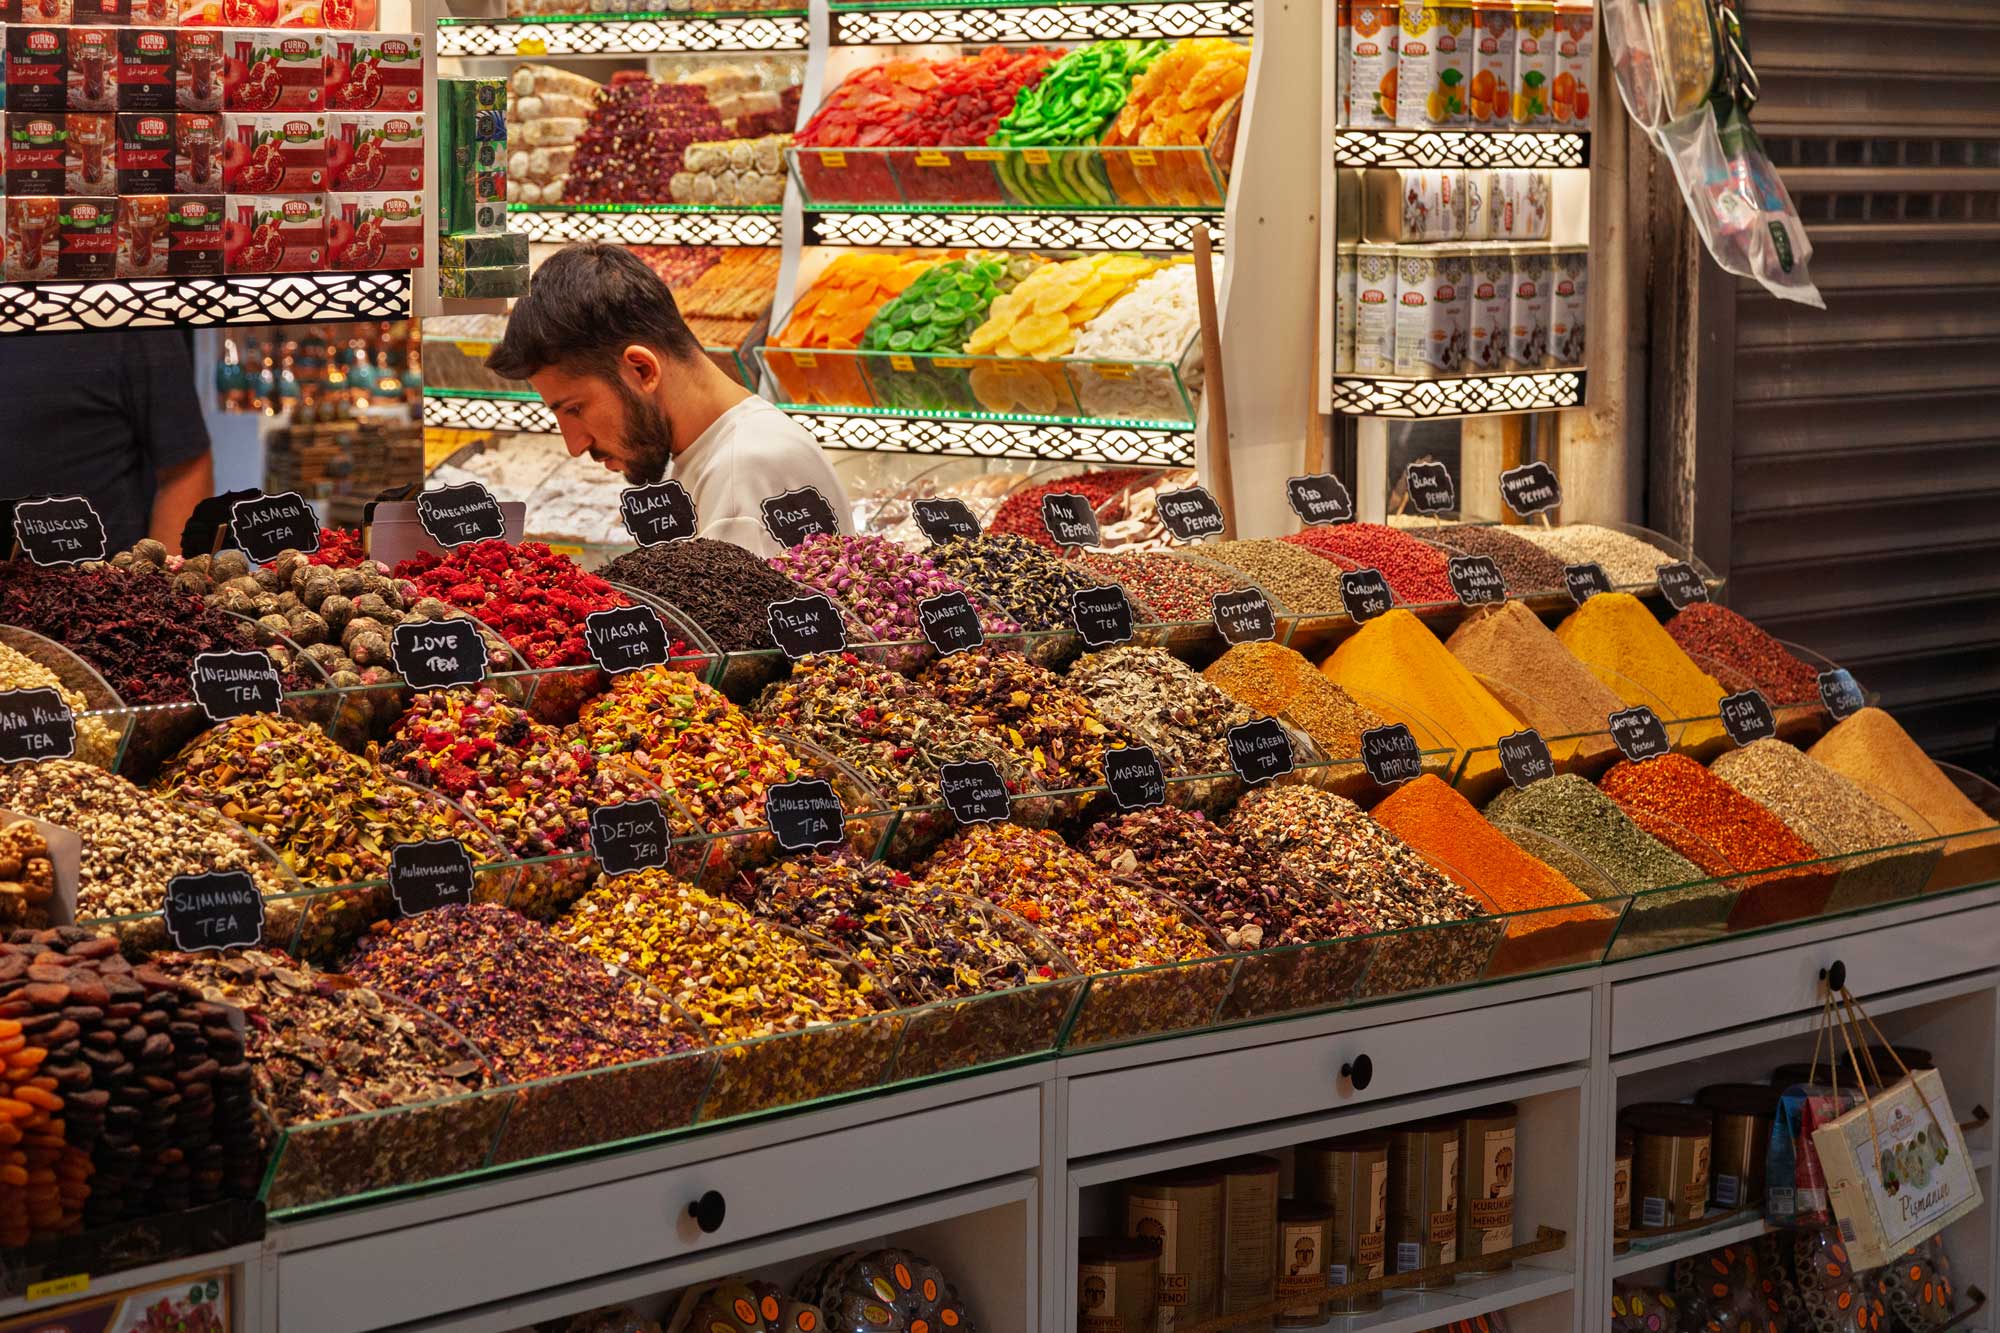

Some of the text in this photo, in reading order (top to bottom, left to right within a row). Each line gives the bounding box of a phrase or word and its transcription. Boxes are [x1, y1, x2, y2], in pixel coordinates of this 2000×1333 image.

[30, 32, 55, 44] TURKO
[140, 34, 165, 44] TURKO
[284, 40, 307, 49] TURKO
[384, 42, 406, 50] TURKO
[30, 122, 53, 131] TURKO
[140, 120, 164, 130] TURKO
[286, 123, 308, 132] TURKO
[386, 122, 408, 130] TURKO
[73, 207, 96, 215] TURKO
[182, 205, 204, 213] TURKO
[285, 203, 308, 211] TURKO
[1411, 472, 1438, 489] BLACK
[1506, 474, 1535, 492] WHITE
[1297, 486, 1321, 501] RED
[1518, 485, 1553, 504] PEPPER
[422, 500, 494, 522] POMEGRANATE
[626, 492, 671, 516] BLACH
[1050, 503, 1074, 520] MIX
[1164, 500, 1204, 517] GREEN
[1308, 499, 1342, 516] PEPPER
[242, 505, 300, 530] JASMEN
[773, 508, 811, 527] ROSE
[920, 506, 950, 522] BLU
[454, 522, 481, 536] TEA
[648, 513, 678, 534] TEA
[798, 521, 823, 535] TEA
[949, 522, 972, 532] TEA
[1060, 521, 1094, 538] PEPPER
[1182, 513, 1222, 533] PEPPER
[262, 526, 294, 544] TEA
[51, 538, 82, 552] TEA
[1453, 563, 1491, 580] GARAM
[1346, 581, 1385, 595] CURCUMA
[1221, 600, 1265, 617] OTTOMAN
[774, 609, 820, 629] RELAX
[1096, 618, 1118, 630] TEA
[592, 621, 649, 645] VIAGRA
[794, 625, 818, 638] TEA
[944, 626, 967, 639] TEA
[411, 634, 458, 653] LOVE
[618, 641, 649, 658] TEA
[426, 656, 459, 672] TEA
[225, 684, 262, 703] TEA
[1726, 700, 1756, 722] FISH
[21, 733, 54, 751] TEA
[1234, 735, 1284, 756] MIX GREEN
[1370, 735, 1413, 755] SMOKED
[1257, 752, 1278, 768] TEA
[1504, 744, 1532, 762] MINT
[1113, 764, 1155, 781] MASALA
[945, 778, 983, 793] SECRET
[1139, 782, 1160, 799] TEA
[962, 804, 987, 815] TEA
[600, 820, 657, 842] DETOX
[797, 817, 828, 835] TEA
[630, 843, 658, 862] TEA
[174, 890, 252, 912] SLIMMING
[195, 914, 238, 937] TEA
